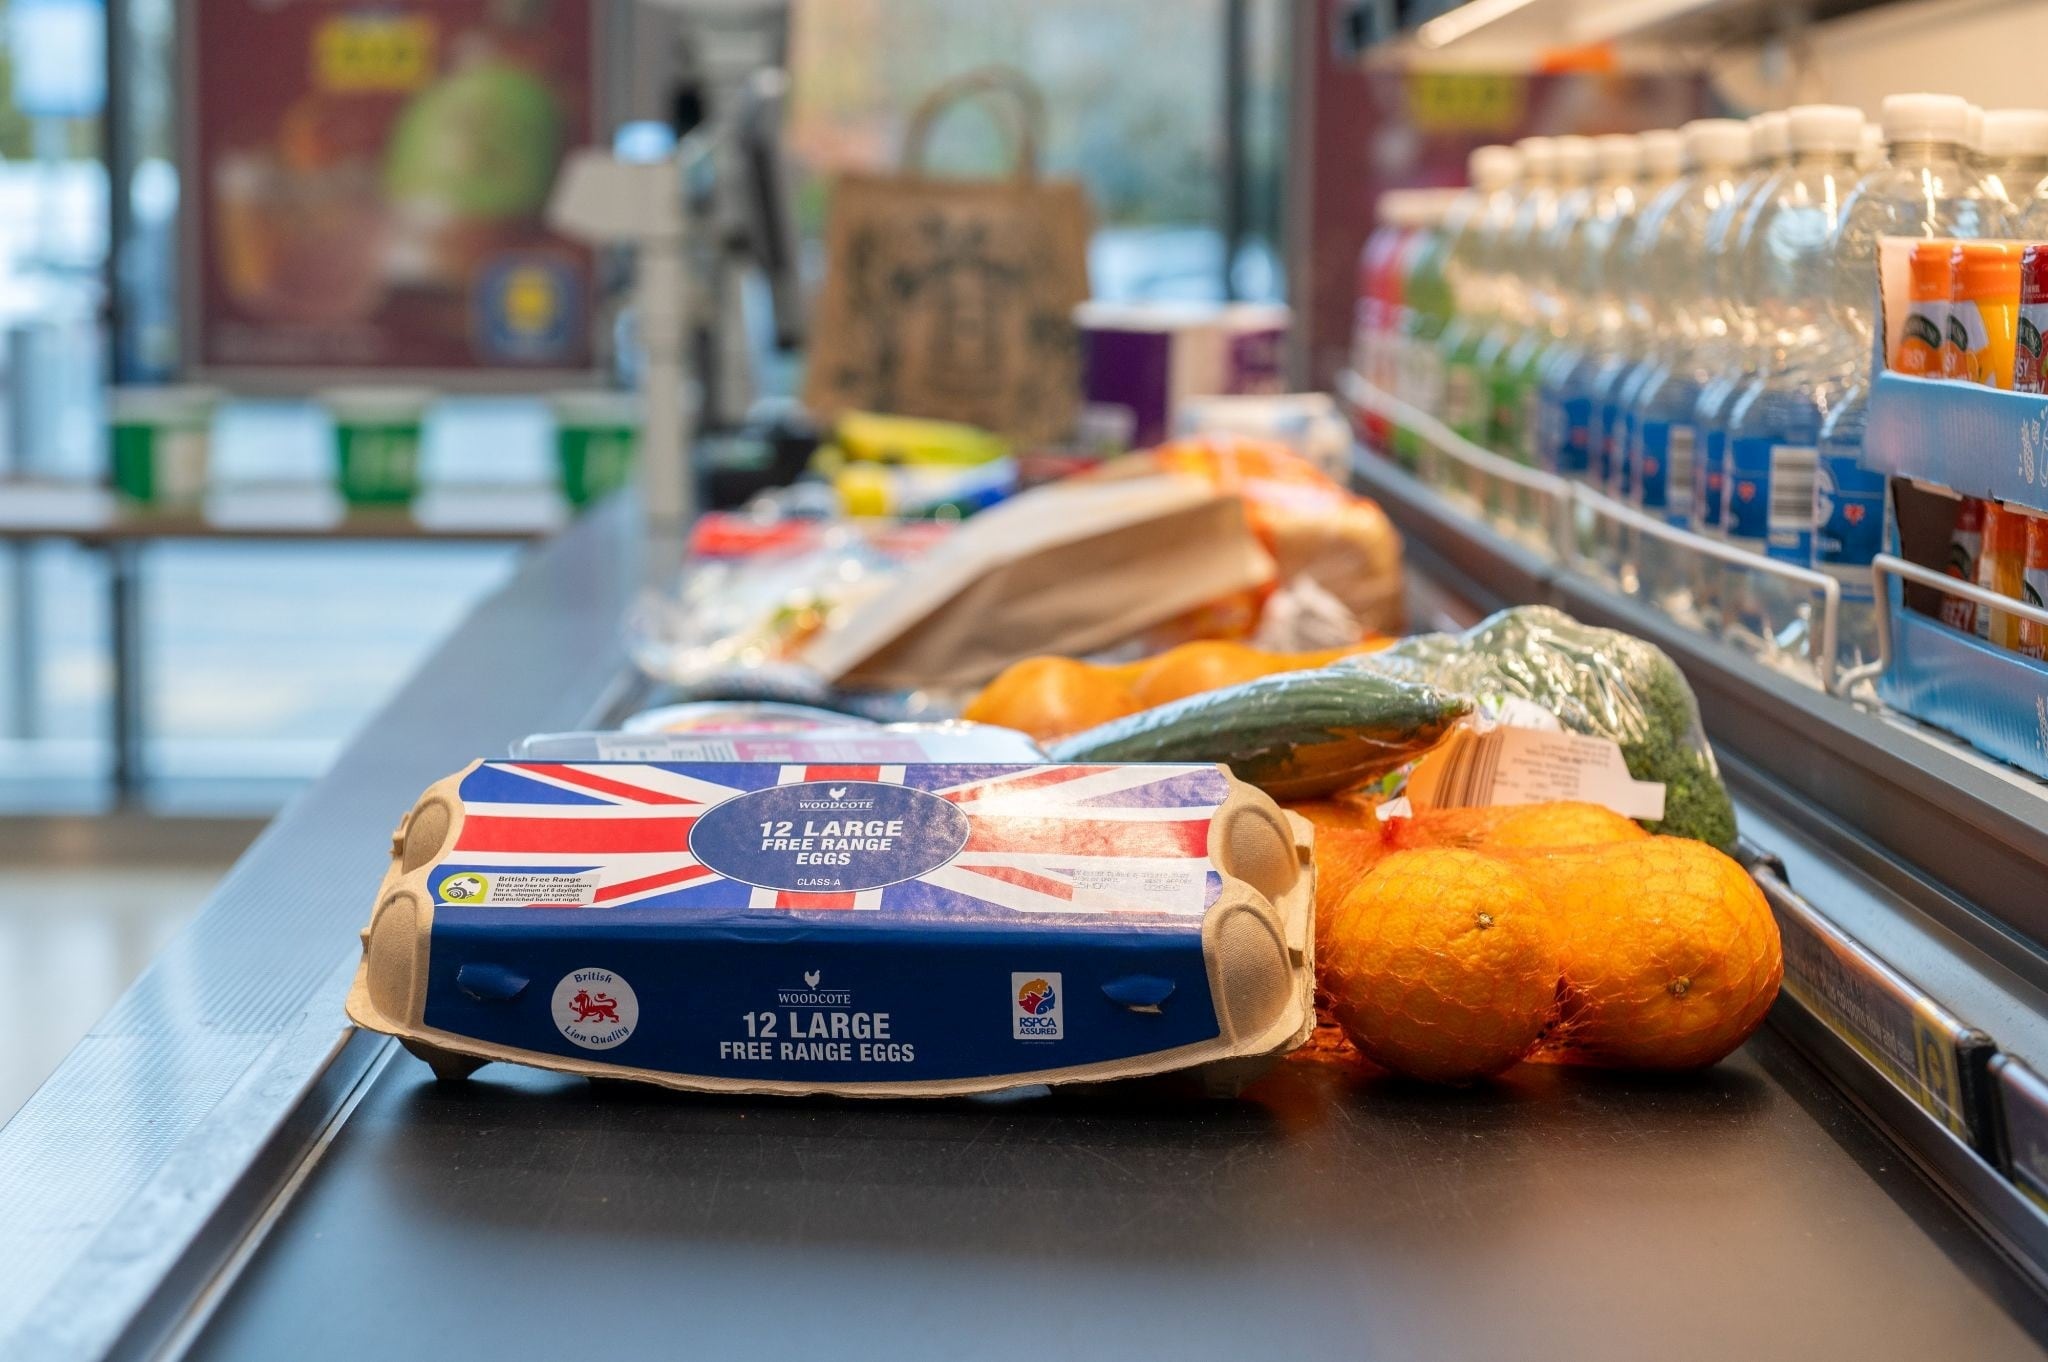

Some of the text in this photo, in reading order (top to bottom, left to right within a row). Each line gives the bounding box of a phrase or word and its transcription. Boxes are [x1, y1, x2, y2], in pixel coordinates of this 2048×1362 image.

[799, 801, 874, 810] WOODCOTE
[760, 821, 904, 838] 12 LARGE
[762, 839, 893, 851] FREE RANGE
[797, 853, 851, 866] EGGS
[797, 878, 841, 886] CLASS A
[574, 972, 612, 984] British
[779, 994, 851, 1004] WOODCOTE
[743, 1012, 891, 1039] 12 LARGE
[1020, 1018, 1056, 1027] RSPCA
[564, 1026, 630, 1044] Lion Quality
[720, 1042, 915, 1062] FREE RANGE EGGS
